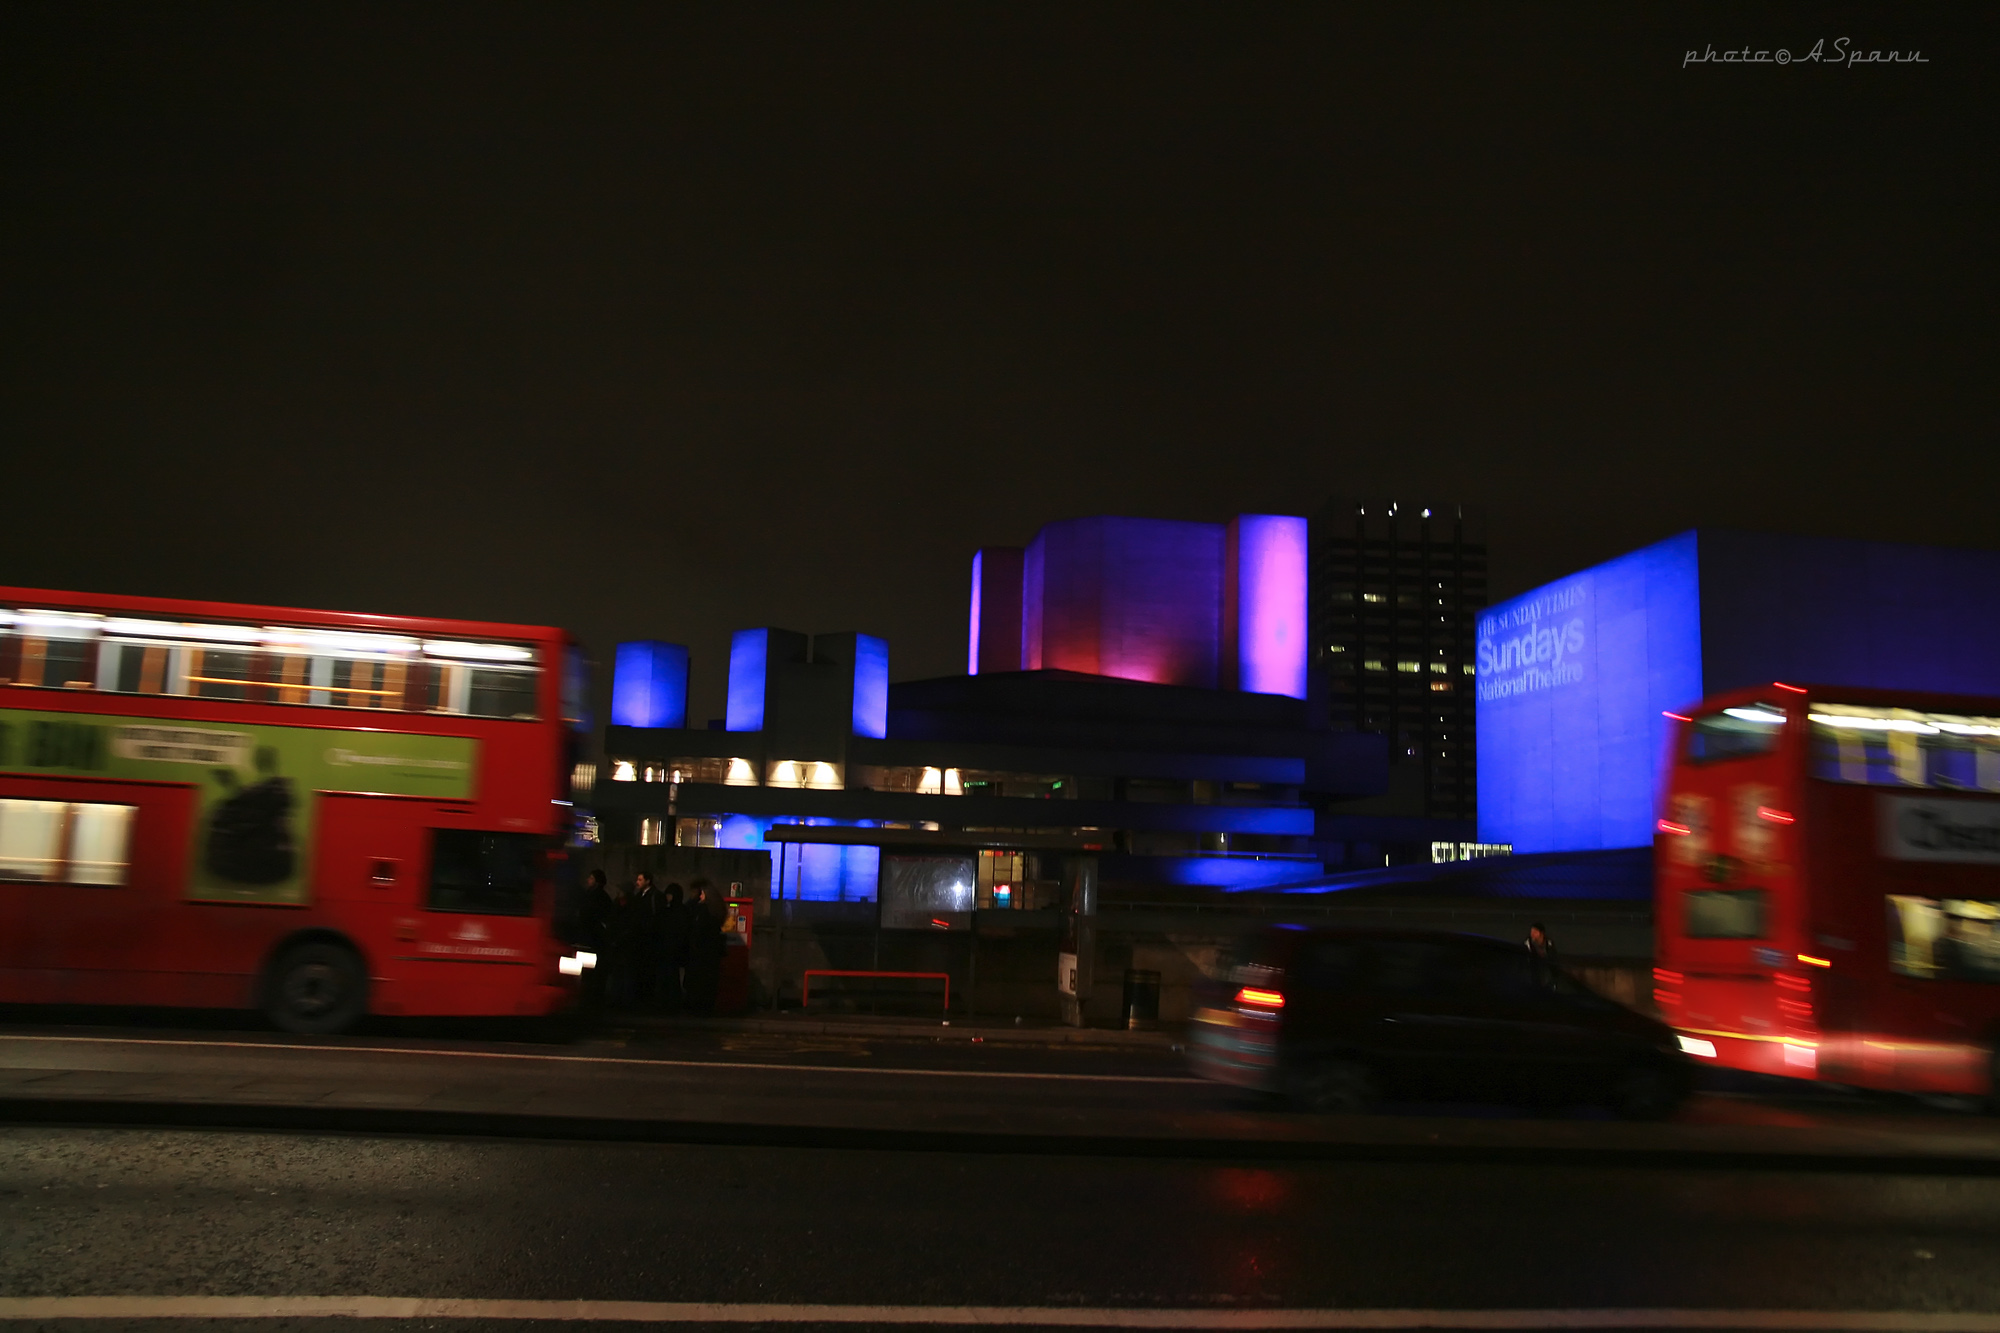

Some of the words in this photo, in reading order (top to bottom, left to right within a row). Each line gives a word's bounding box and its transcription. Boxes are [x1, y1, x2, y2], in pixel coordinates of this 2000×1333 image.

[1478, 616, 1497, 638] THE
[1498, 600, 1543, 629] SUNDAY
[1545, 584, 1586, 616] TIMES
[1478, 618, 1584, 677] Sundays
